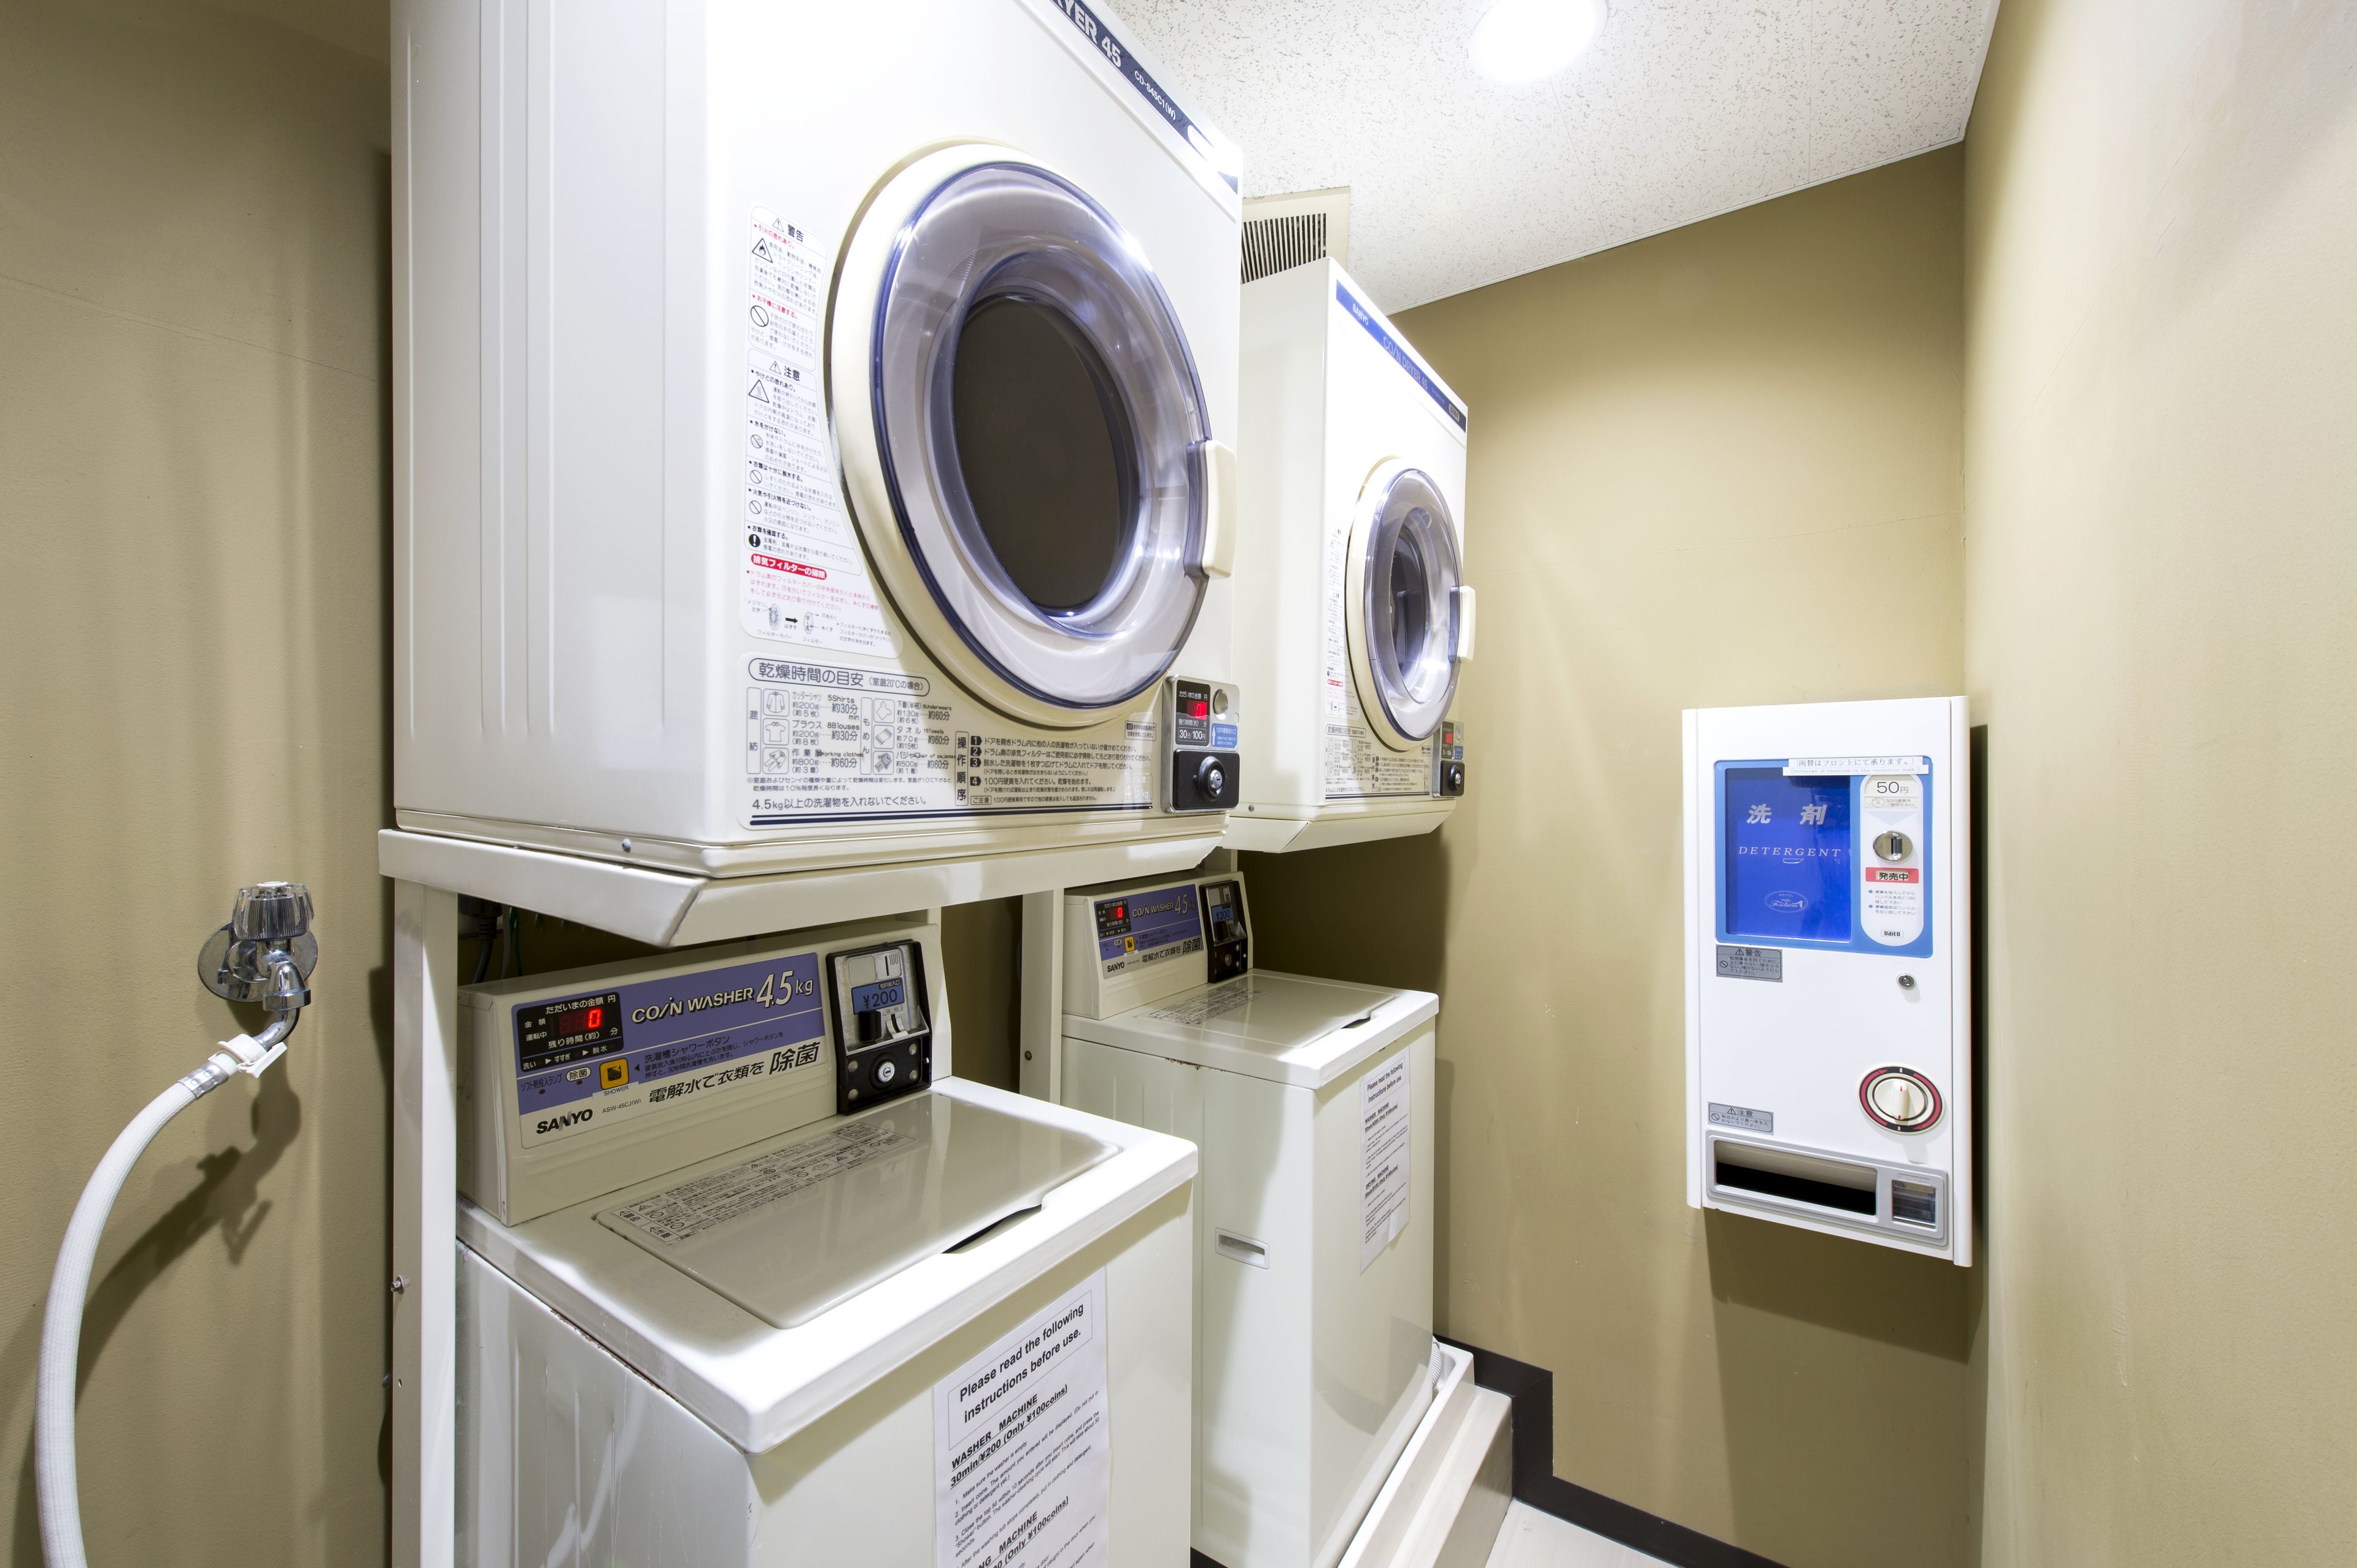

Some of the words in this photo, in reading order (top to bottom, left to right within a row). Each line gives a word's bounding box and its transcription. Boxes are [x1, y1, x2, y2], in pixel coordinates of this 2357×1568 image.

[1058, 0, 1097, 44] YER
[1102, 36, 1121, 68] 45
[1135, 71, 1176, 120] CD-S45C1(W)
[788, 224, 803, 242] 警告
[1352, 303, 1369, 326] SANYO
[784, 366, 800, 382] 注意
[1402, 355, 1420, 384] DRYER
[1422, 377, 1428, 390] 45
[753, 555, 826, 579] 排気フィルターの掃除
[759, 662, 864, 687] 乾燥時間の目安
[831, 703, 858, 714] 約30分
[927, 711, 950, 721] 約60分
[831, 730, 858, 741] 約30分
[927, 735, 950, 746] 約60分
[973, 736, 978, 745] 1
[972, 747, 978, 756] 2
[830, 757, 857, 768] 約60分
[927, 760, 949, 769] 約60分
[1798, 759, 1909, 767] 両替はフロントにて承ります。
[972, 777, 977, 786] 4
[1738, 846, 1841, 857] DETERGENT
[1879, 872, 1908, 881] 発売中
[1117, 907, 1123, 918] 0
[1150, 902, 1174, 913] WASHER
[1217, 910, 1231, 921] ¥200
[1182, 938, 1201, 954] 除菌
[1107, 962, 1124, 973] SANYO
[546, 997, 604, 1014] ただいまの金額
[687, 986, 755, 1012] WASHER
[863, 989, 897, 1009] ¥200
[587, 1009, 601, 1029] 0
[525, 1031, 548, 1041] 運転中
[610, 1027, 618, 1036] 分
[523, 1061, 536, 1070] 洗い
[554, 1053, 570, 1063] すすぎ
[592, 1045, 608, 1055] 脱水
[644, 1036, 730, 1062] 洗濯槽シャワーボタン
[568, 1068, 587, 1080] 除菌
[649, 1061, 764, 1103] 電解水で衣類を
[769, 1041, 821, 1075] 除菌
[1367, 1080, 1378, 1091] Please
[1390, 1062, 1403, 1076] following
[603, 1085, 629, 1096] SHOWER
[1368, 1086, 1387, 1103] instructions
[1387, 1079, 1396, 1090] before
[536, 1109, 593, 1134] SANYO
[1365, 1112, 1376, 1123] WASHER
[1378, 1102, 1389, 1114] MACHINE
[1736, 1109, 1753, 1118] 注意
[960, 1368, 997, 1402] Please
[1000, 1346, 1022, 1373] read
[1025, 1337, 1040, 1354] the
[1043, 1303, 1084, 1340] following
[964, 1368, 1028, 1423] instructions
[1031, 1343, 1060, 1372] before
[1063, 1329, 1081, 1347] use.
[1004, 1420, 1024, 1445] (Only
[1026, 1384, 1067, 1423] ¥100coins)
[952, 1431, 992, 1469] WASHER
[999, 1394, 1038, 1431] MACHINE
[961, 1497, 975, 1512] Insert
[990, 1477, 999, 1486] The
[1000, 1462, 1016, 1478] amount
[1026, 1440, 1040, 1456] entered
[962, 1486, 975, 1499] Make
[976, 1477, 986, 1488] sure
[994, 1456, 1010, 1471] washer
[955, 1508, 973, 1526] clothing
[979, 1483, 1000, 1505] detergent
[961, 1522, 975, 1536] Close
[999, 1489, 1011, 1503] within
[1018, 1468, 1034, 1485] seconds
[993, 1505, 1001, 1515] The
[981, 1531, 999, 1550] washing
[1007, 1513, 1018, 1526] stops
[999, 1511, 1037, 1554] MACHINE
[1005, 1539, 1026, 1564] (Only
